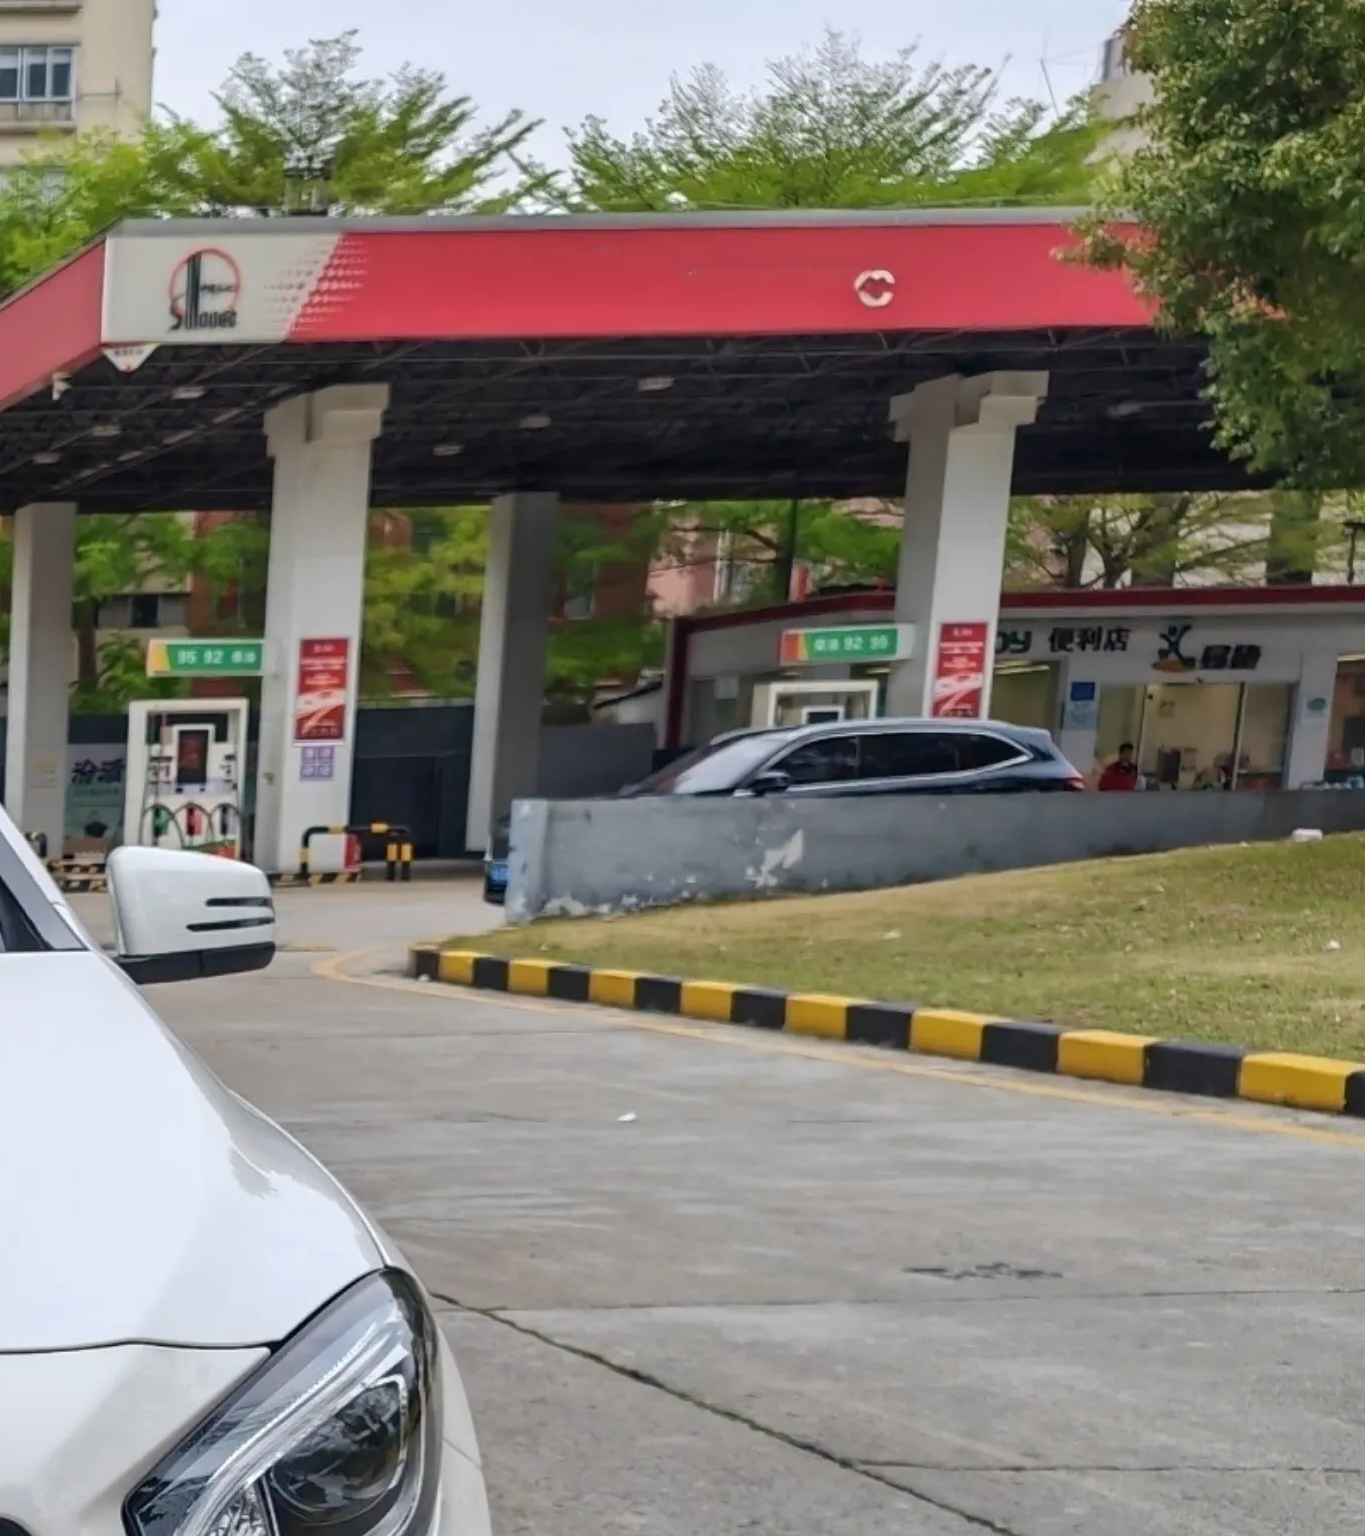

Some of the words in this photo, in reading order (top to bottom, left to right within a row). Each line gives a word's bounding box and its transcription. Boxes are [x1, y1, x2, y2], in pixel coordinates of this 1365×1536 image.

[843, 635, 863, 651] 92
[1049, 626, 1131, 652] 便利店
